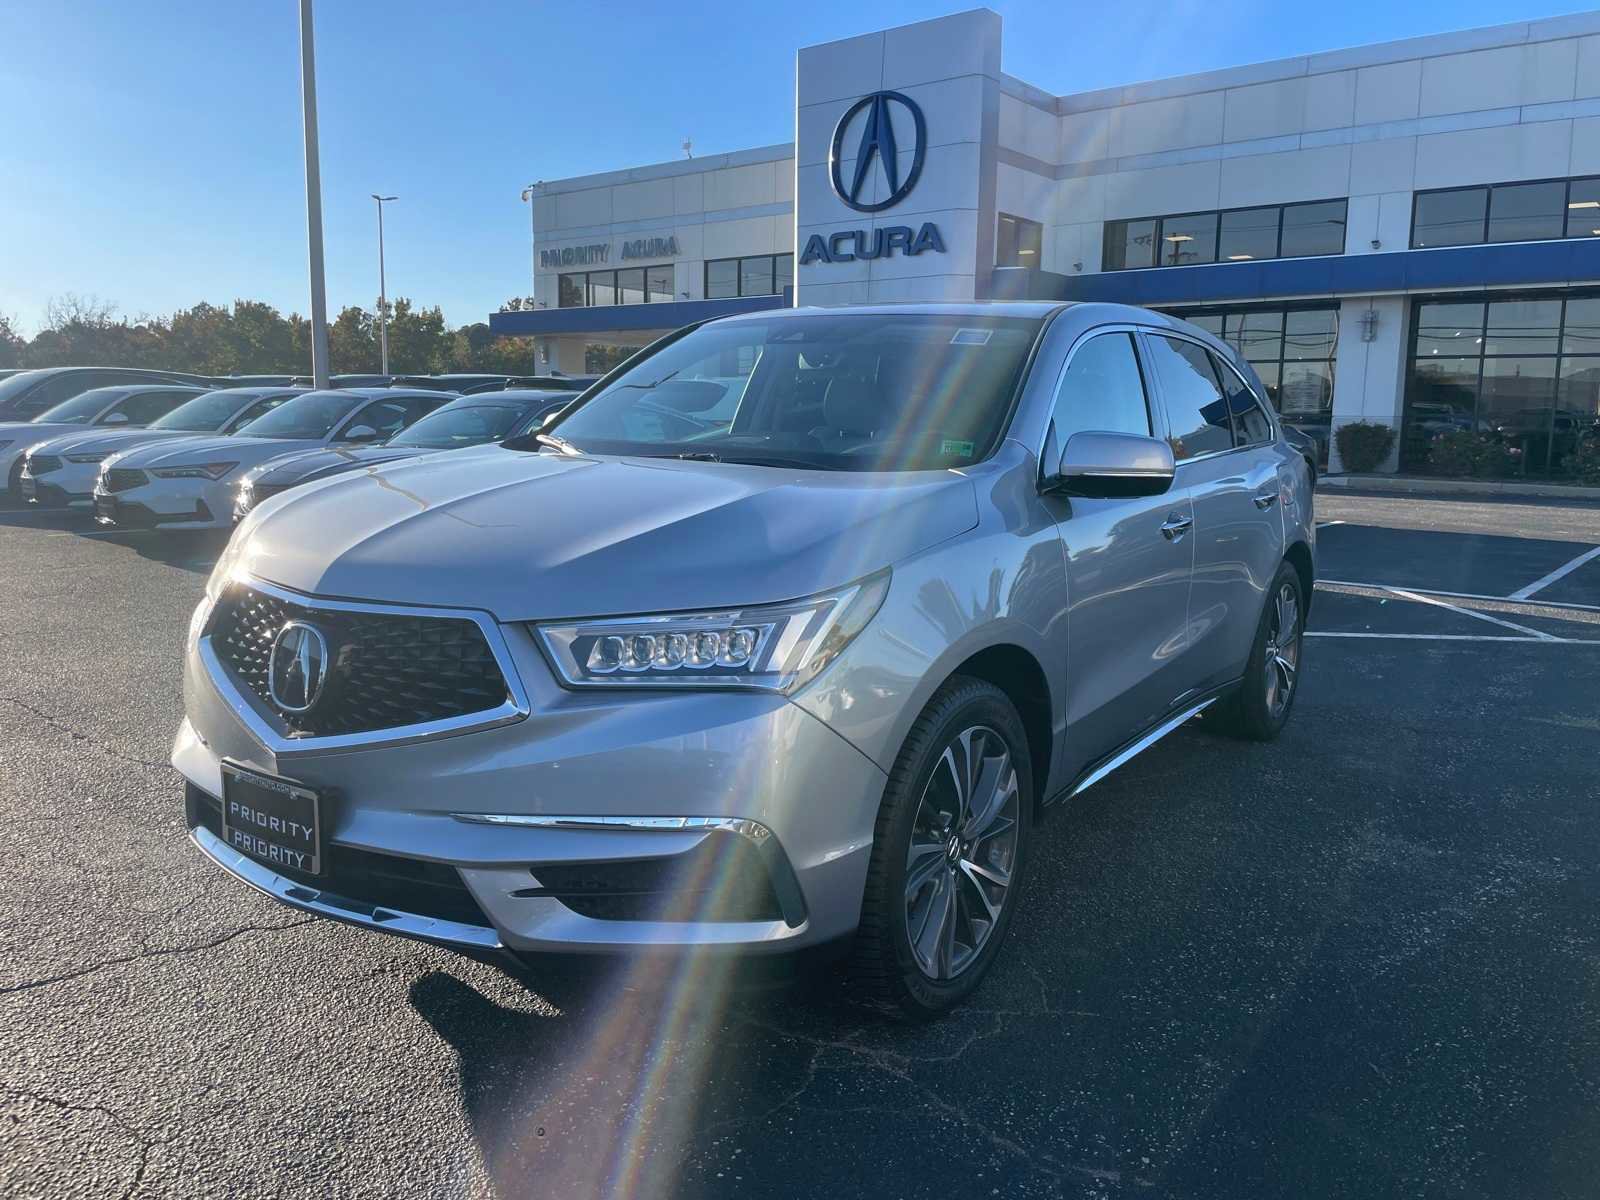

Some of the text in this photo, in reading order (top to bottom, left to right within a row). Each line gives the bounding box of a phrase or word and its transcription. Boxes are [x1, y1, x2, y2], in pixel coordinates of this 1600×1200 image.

[799, 222, 947, 265] ACURA
[231, 801, 312, 840] PRIORITY
[234, 831, 304, 869] PRIORITY
